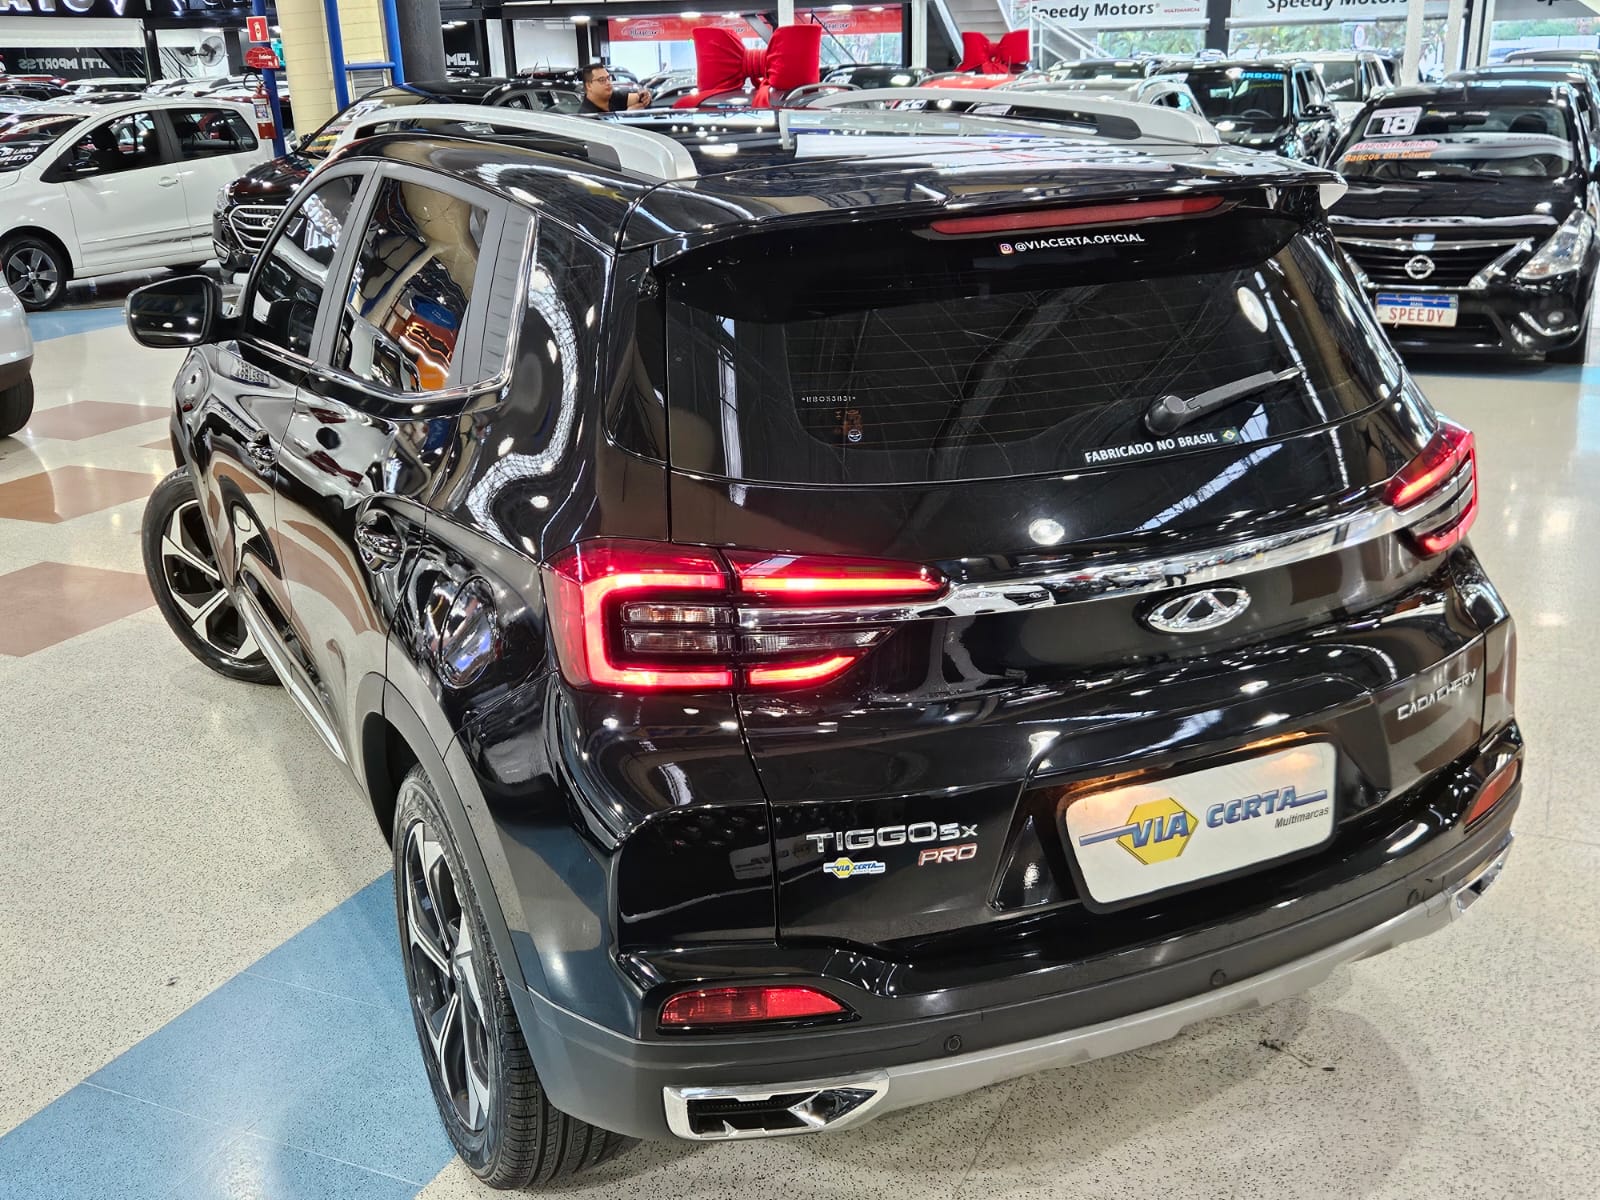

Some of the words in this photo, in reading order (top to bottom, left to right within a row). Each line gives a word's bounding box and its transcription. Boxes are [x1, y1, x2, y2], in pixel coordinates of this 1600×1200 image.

[1094, 3, 1154, 17] Motors
[1014, 233, 1146, 252] @VIACERTA.OFICIAL
[1389, 307, 1445, 322] SPEEDY
[1084, 442, 1154, 463] FABRICADO
[1156, 439, 1176, 451] NO
[1178, 433, 1218, 448] BRASIL
[1436, 668, 1477, 701] CHERY
[1130, 811, 1191, 848] VIA
[1206, 785, 1298, 829] CERTA
[1274, 805, 1330, 830] Multimarcas
[853, 862, 878, 870] CERTA
[917, 842, 978, 867] PRO
